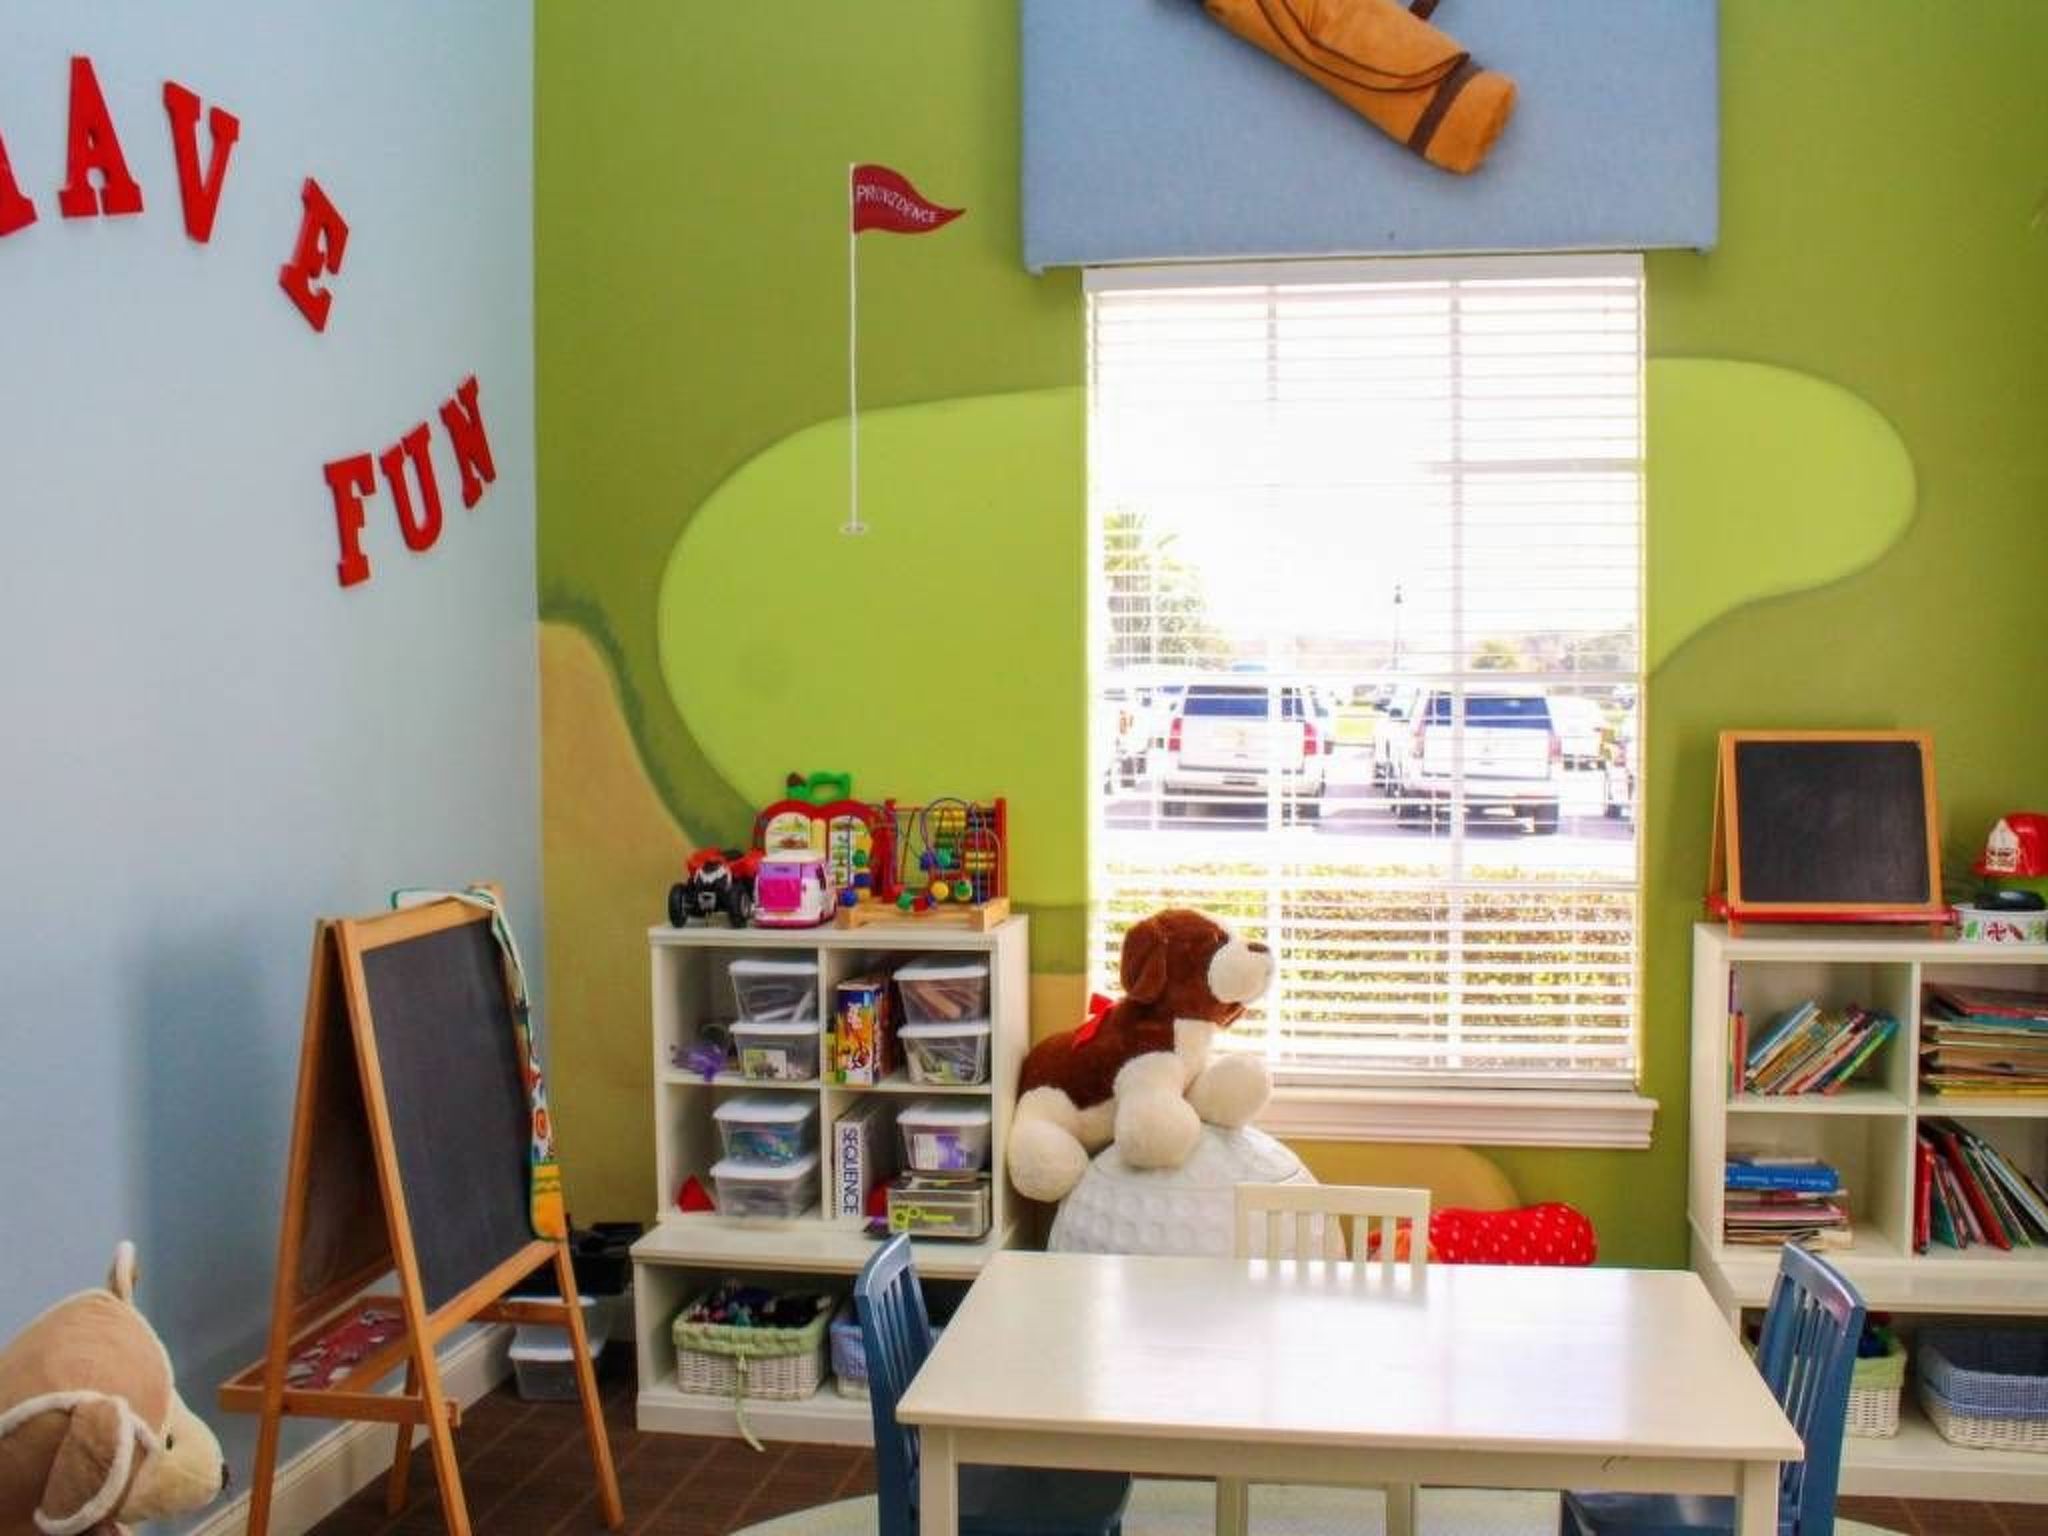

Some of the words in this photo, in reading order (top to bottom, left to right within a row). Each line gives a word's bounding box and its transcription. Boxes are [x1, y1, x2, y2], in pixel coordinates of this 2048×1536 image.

[856, 185, 937, 224] PROVIDENCE
[324, 376, 497, 587] FUN
[842, 1127, 860, 1216] SEQUENCE
